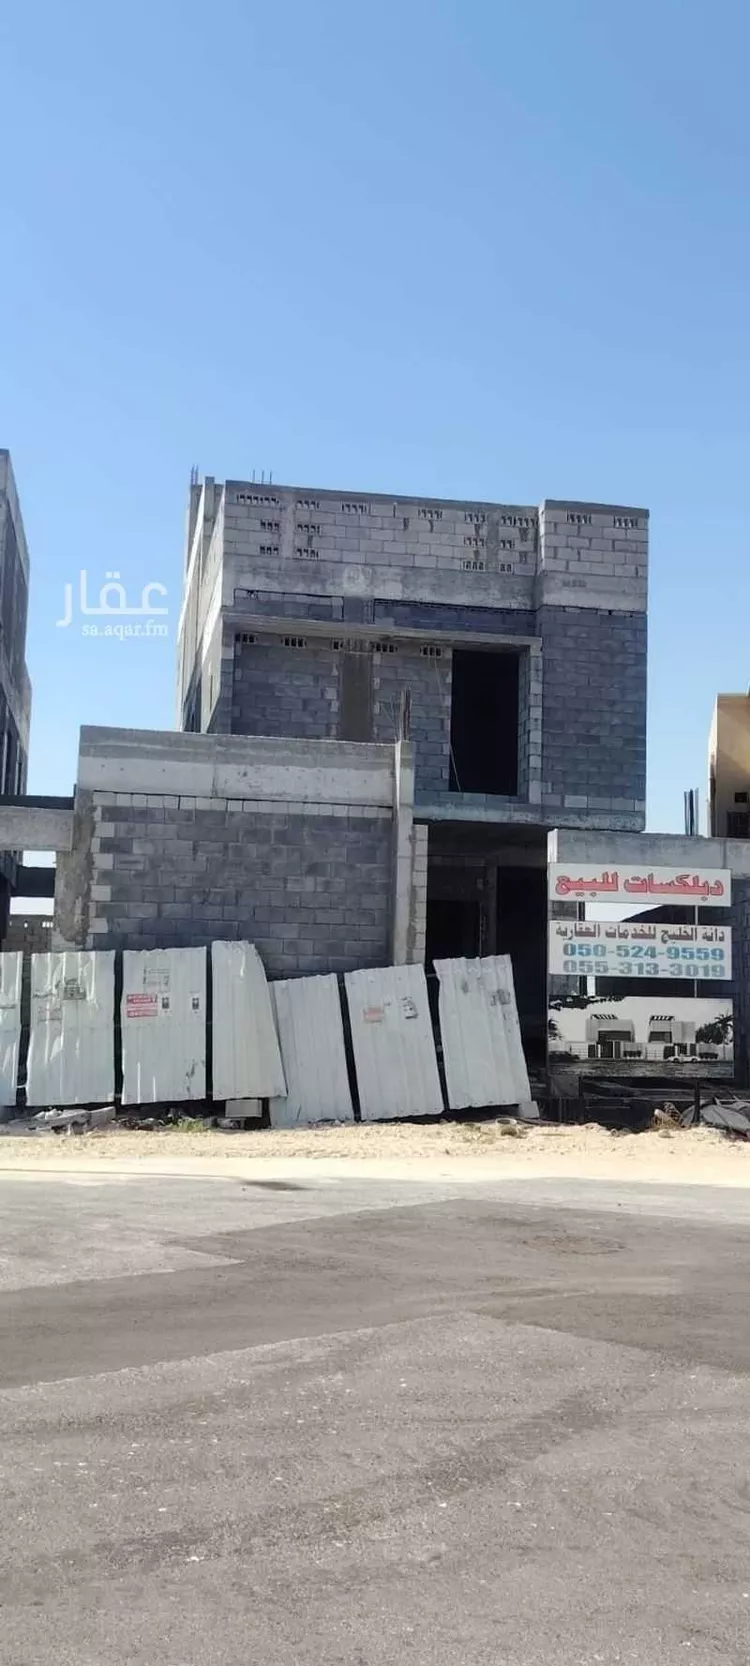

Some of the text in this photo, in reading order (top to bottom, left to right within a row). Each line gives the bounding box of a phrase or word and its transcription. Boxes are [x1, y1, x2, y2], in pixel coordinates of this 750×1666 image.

[555, 871, 724, 901] دبلكسات للبيع
[555, 922, 725, 944] دانة الخليج للخدمات العقارية
[562, 959, 726, 978] 055-313-3019
